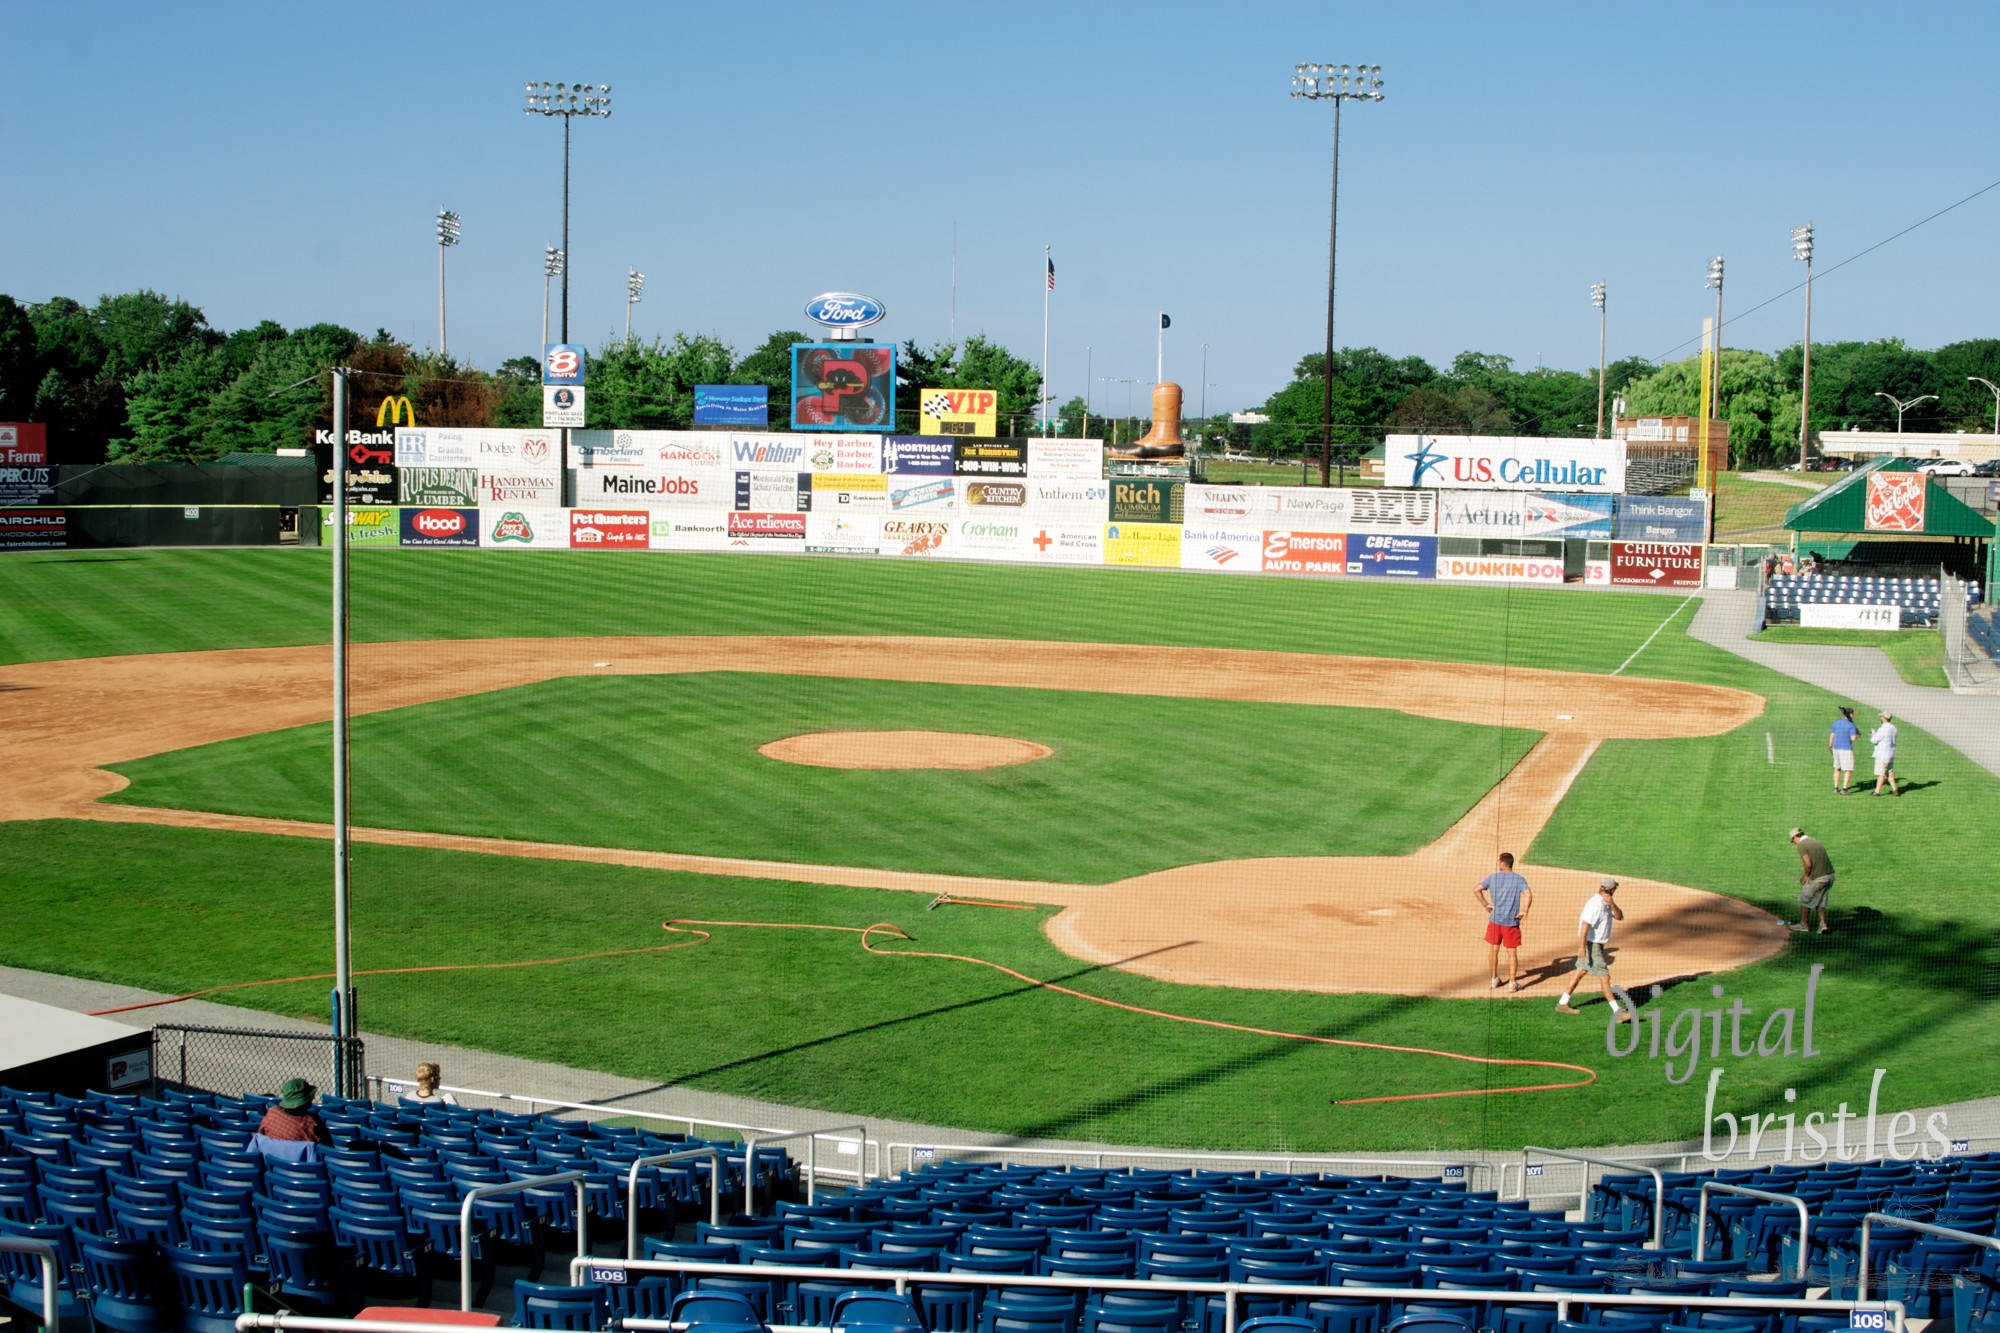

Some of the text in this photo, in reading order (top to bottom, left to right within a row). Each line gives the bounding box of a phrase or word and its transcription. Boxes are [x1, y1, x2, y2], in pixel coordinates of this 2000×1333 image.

[819, 299, 866, 321] Ford
[549, 351, 579, 374] 8
[946, 392, 995, 414] VIP
[951, 423, 967, 433] 64
[438, 432, 462, 441] Paving
[480, 441, 516, 456] Dodge
[813, 439, 876, 449] Hey Barber,
[897, 443, 953, 453] NORTHEAST
[8, 449, 42, 463] Farm
[578, 446, 644, 456] Cumberland
[660, 450, 715, 461] HANCOCK
[733, 441, 803, 464] Webber
[963, 447, 977, 456] JOE
[429, 454, 472, 462] Countertops
[836, 460, 875, 469] Barber.
[954, 460, 1027, 473] 1-800-WIN-WIN-1
[1123, 465, 1169, 475] L.L. Bean
[1454, 457, 1606, 486] U.S. Cellular
[400, 467, 478, 503] RUFUS DEERING
[481, 475, 554, 489] HANDYMAN
[492, 487, 540, 501] RENTAL
[981, 485, 1023, 499] COUNTRY
[1037, 487, 1083, 500] Anthem
[1115, 483, 1160, 504] Rich
[1690, 490, 1704, 499] 330
[414, 494, 465, 506] LUMBER
[1287, 498, 1345, 513] NewPage
[1867, 475, 1921, 527] Coca-Cola
[1114, 503, 1161, 512] ALUMINUM
[1630, 504, 1656, 516] Think
[323, 510, 390, 527] SBWAY
[572, 513, 648, 525] Pet Quarters
[1458, 503, 1521, 526] Aetna
[419, 516, 460, 530] Hood
[730, 513, 804, 530] Ace relievers.
[675, 525, 725, 533] Banknorth
[884, 521, 949, 535] GEARY'S
[961, 520, 1019, 537] Gorham
[1646, 526, 1677, 535] Bangor
[1060, 532, 1097, 540] American
[1184, 530, 1260, 542] Bank of America
[1076, 540, 1097, 548] Cross
[1264, 531, 1343, 559] Emerson
[1365, 536, 1420, 549] CBE ValCom
[809, 545, 876, 554] 1-877-MID-MAINE
[1624, 543, 1692, 556] CHILTON
[1265, 561, 1302, 571] AUTO
[1305, 561, 1342, 573] PARK
[1452, 561, 1525, 577] DUNKIN
[1616, 556, 1701, 570] FURNITURE
[389, 1084, 403, 1093] 109
[1951, 1142, 1967, 1152] 107
[916, 1150, 933, 1158] 108
[1445, 1168, 1463, 1177] 108
[1526, 1166, 1542, 1176] 107
[594, 1270, 624, 1281] 108
[1853, 1314, 1884, 1329] 108
